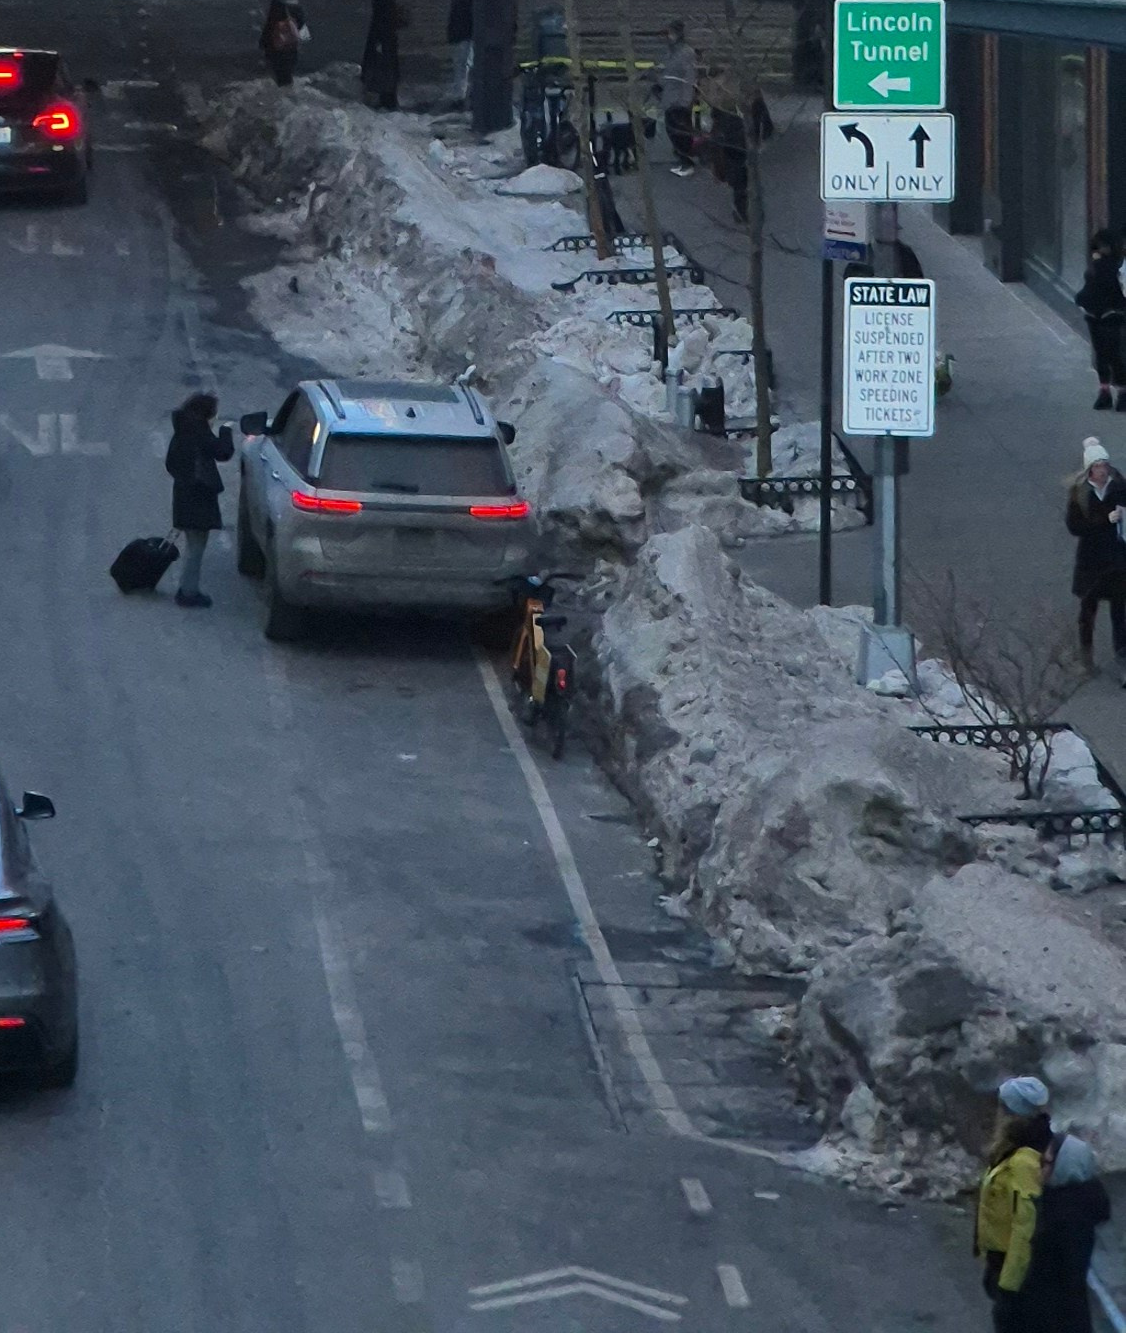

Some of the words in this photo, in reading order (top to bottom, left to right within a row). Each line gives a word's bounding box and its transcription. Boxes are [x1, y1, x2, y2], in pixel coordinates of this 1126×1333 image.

[847, 11, 932, 32] Lincoln
[850, 40, 929, 61] Tunnel
[831, 174, 879, 191] ONLY
[895, 174, 944, 191] ONLY
[852, 286, 895, 303] STATE
[898, 288, 929, 304] LAW
[865, 312, 914, 326] LICENSE
[854, 331, 924, 346] SUSPENDED
[858, 351, 895, 364] AFTER
[897, 351, 921, 364] TWO
[855, 369, 888, 382] WORK
[892, 371, 923, 384] ZONE
[859, 388, 918, 403] SPEEDING
[865, 407, 913, 422] TICKETS
